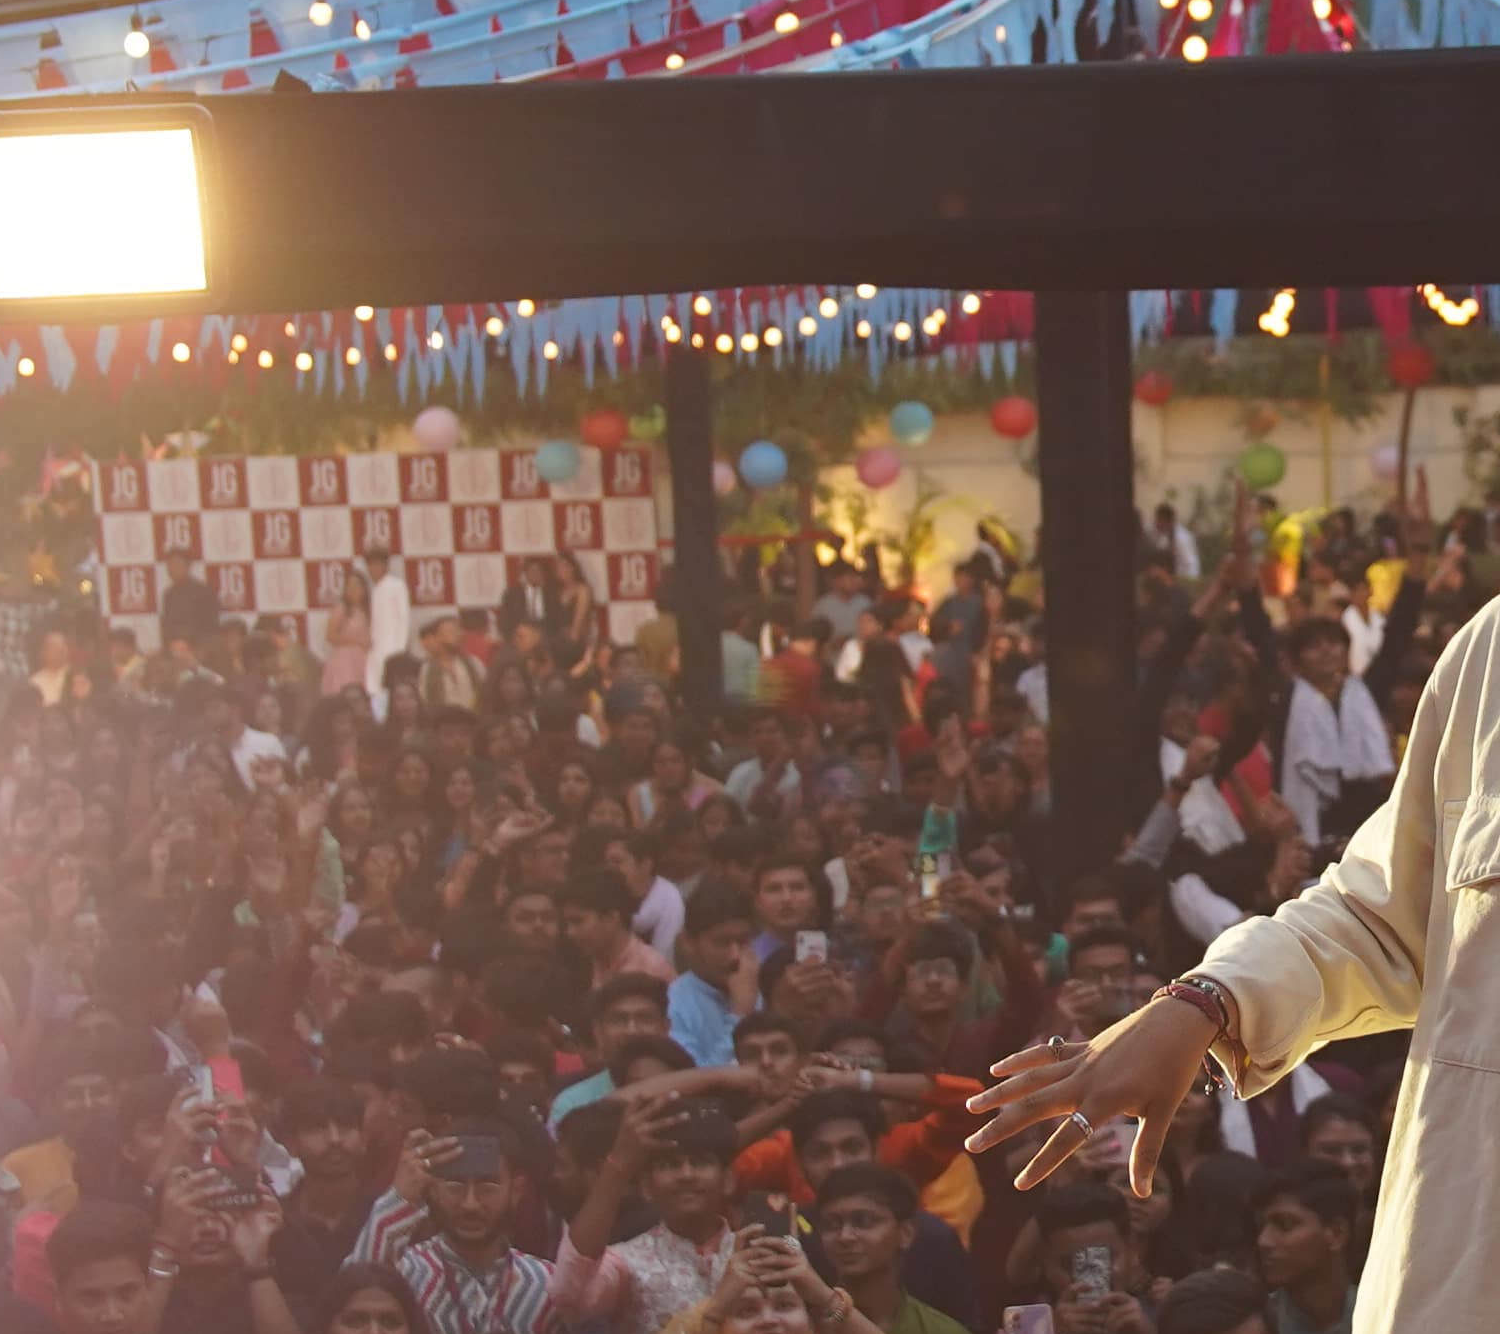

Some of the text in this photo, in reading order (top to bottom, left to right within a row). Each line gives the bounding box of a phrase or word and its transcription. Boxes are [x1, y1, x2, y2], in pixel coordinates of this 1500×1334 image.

[211, 462, 238, 498] JG
[310, 459, 337, 496] JG
[410, 457, 438, 493] JG
[613, 451, 641, 488] JG
[264, 512, 291, 549] JG
[463, 507, 491, 544] JG
[563, 504, 592, 541] JG
[415, 559, 444, 596] JG
[619, 555, 647, 593] JG
